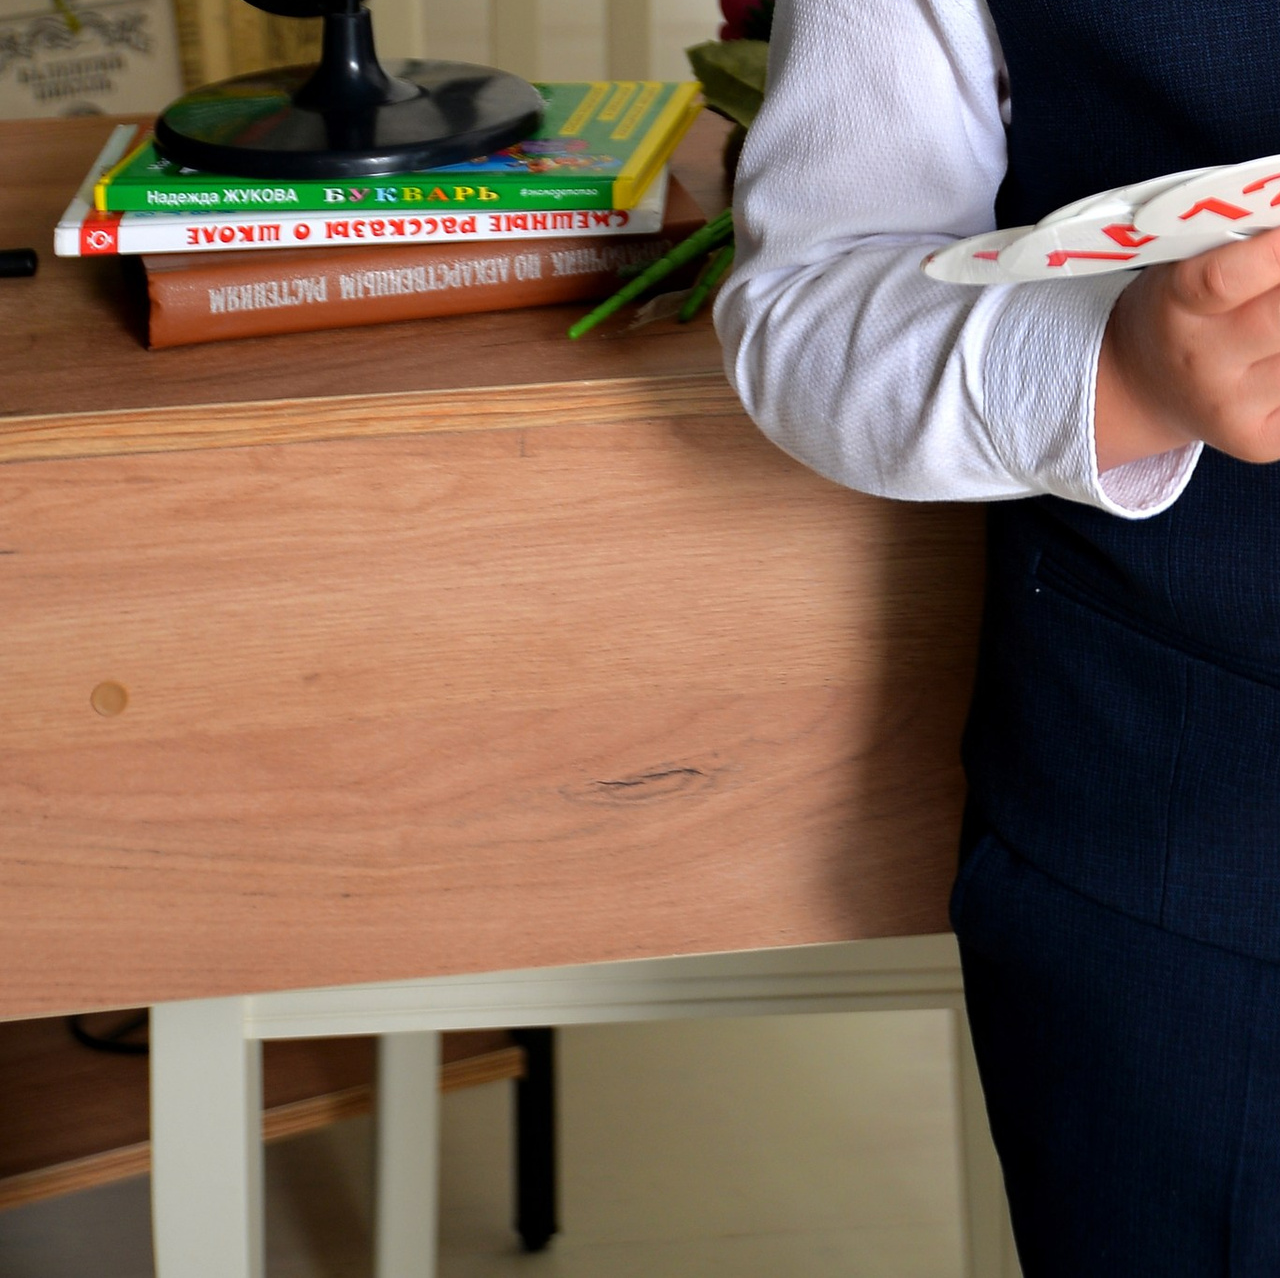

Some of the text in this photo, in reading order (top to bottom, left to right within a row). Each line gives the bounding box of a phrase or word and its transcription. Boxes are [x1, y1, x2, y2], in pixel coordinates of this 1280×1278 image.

[147, 190, 219, 206] Надежда
[222, 187, 299, 204] ЖУКОВА
[323, 186, 500, 204] БУКВАРЬ
[186, 210, 630, 245] СМЕШНЫЕ РАССКАЗЫ О ШКОЛЕ
[208, 275, 329, 314] РАСТЕНИЯМ
[339, 255, 511, 300] ЛЕКАРСТВЕННЫМ
